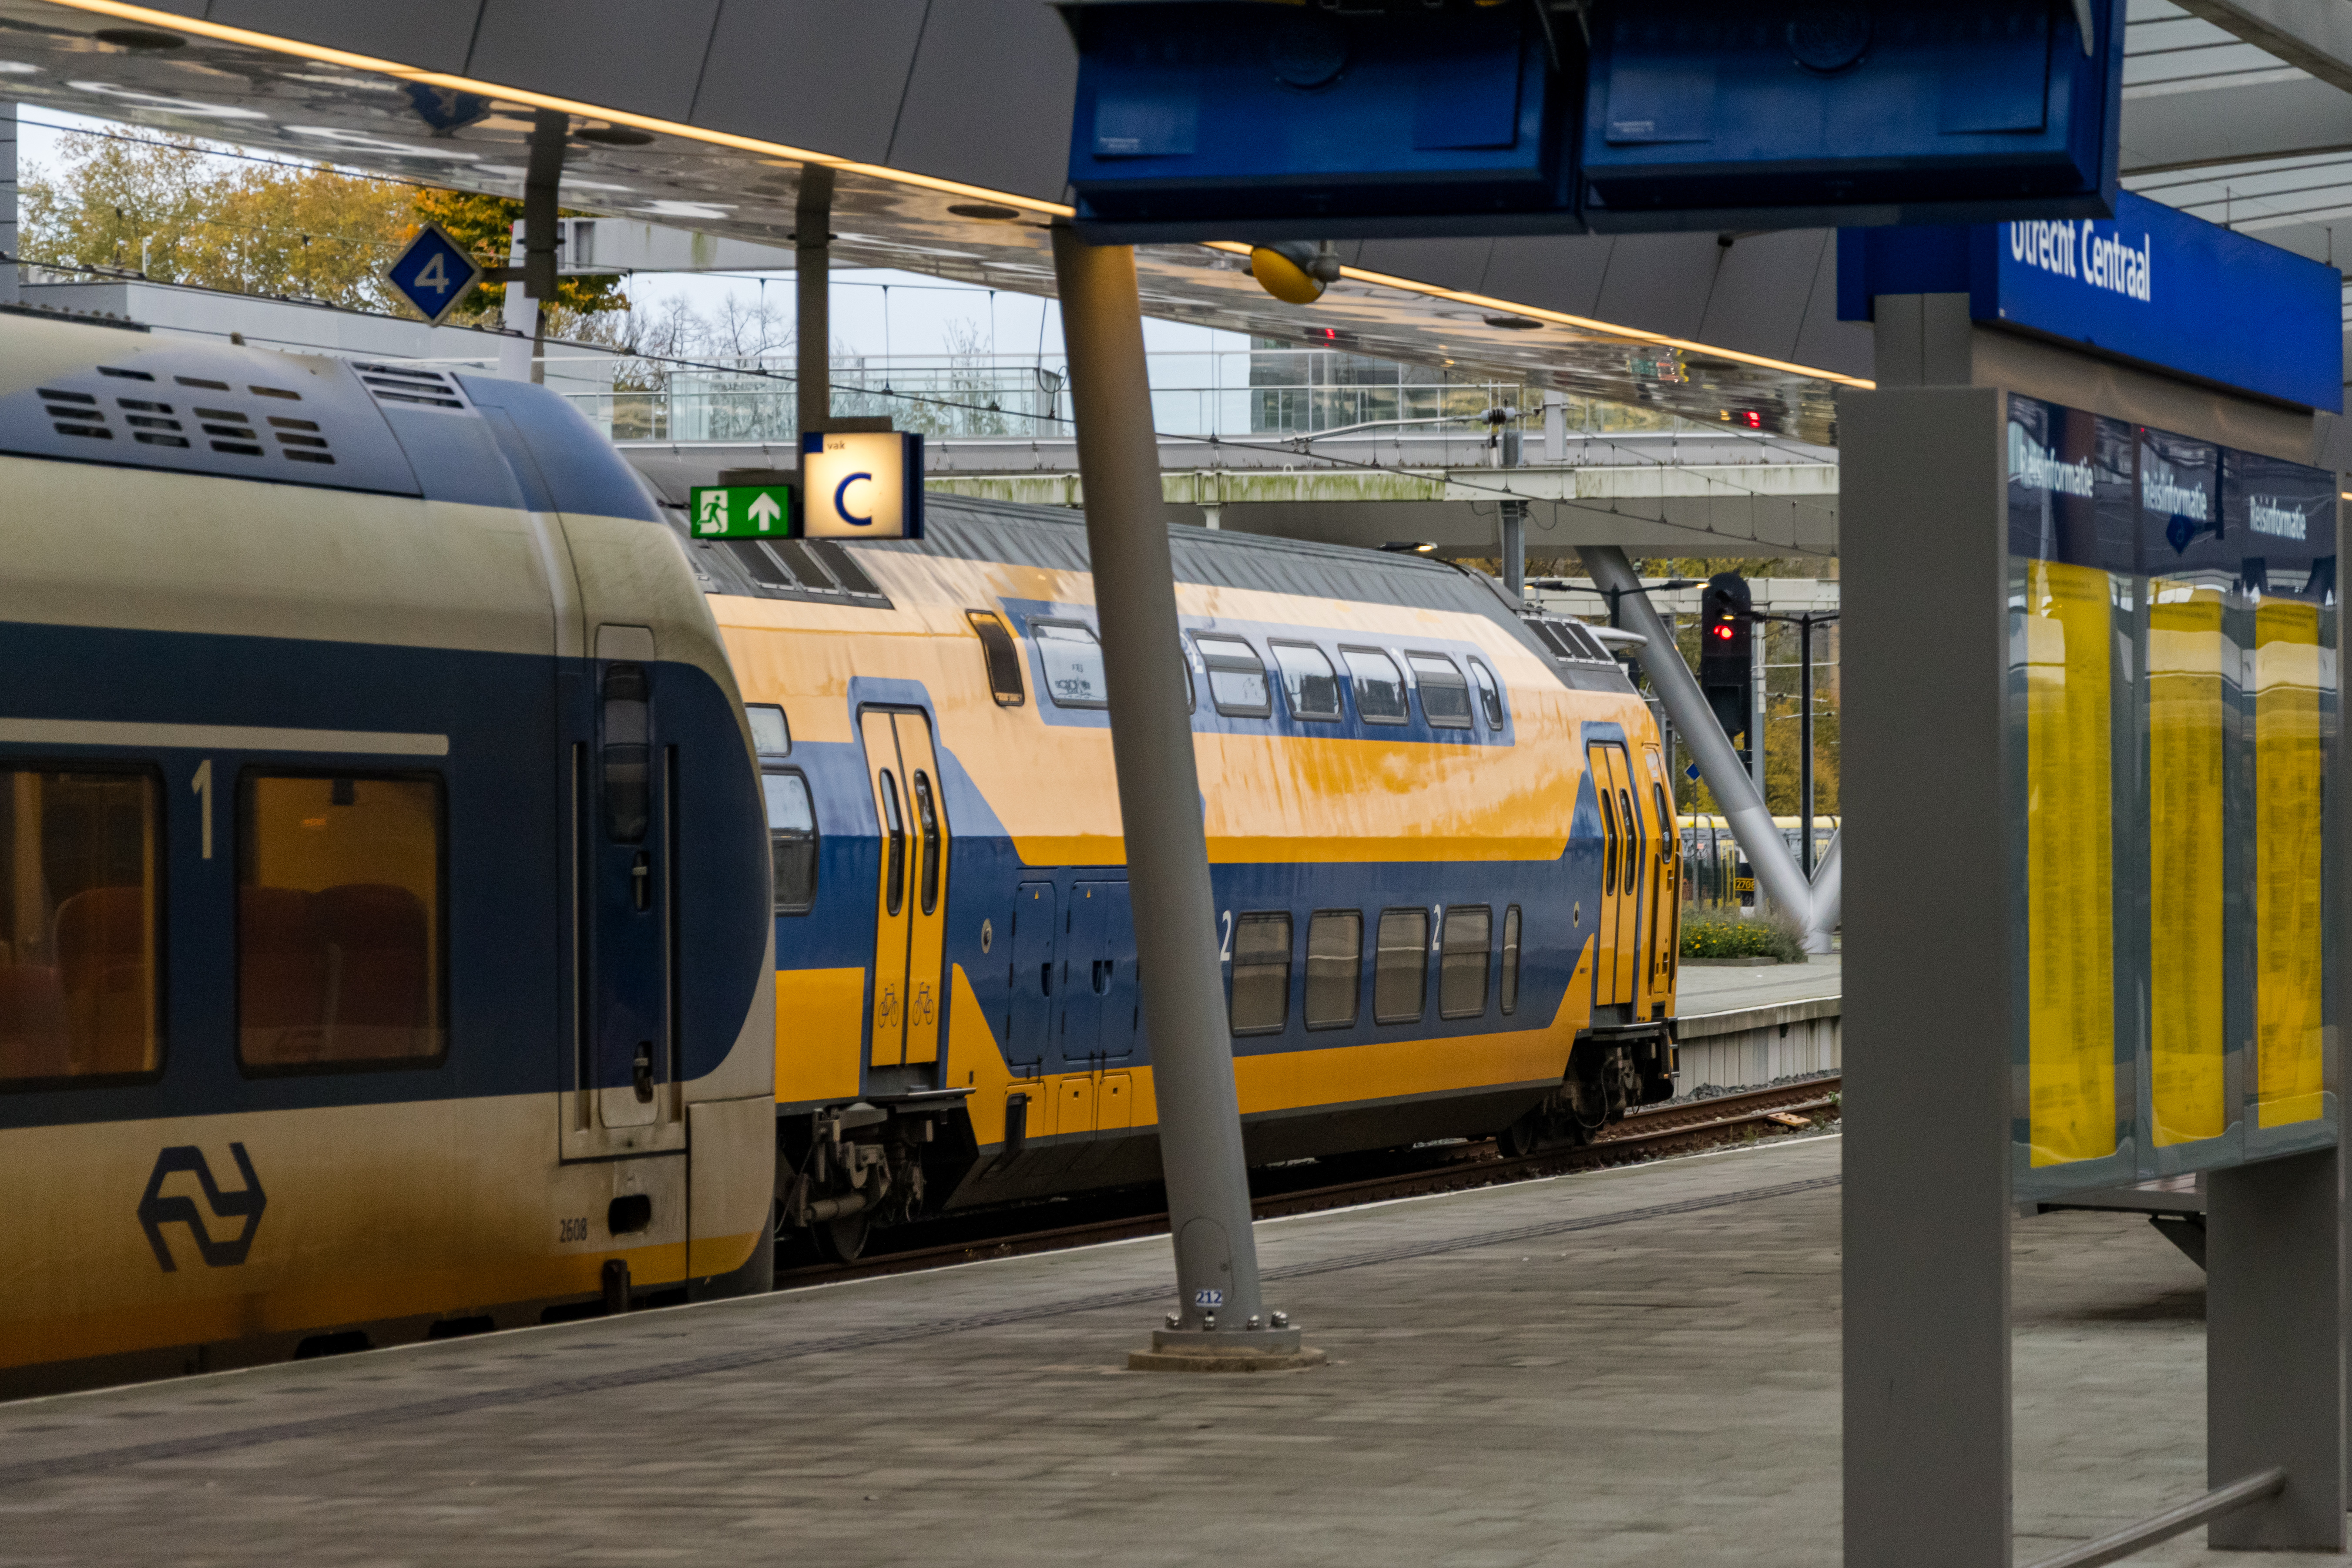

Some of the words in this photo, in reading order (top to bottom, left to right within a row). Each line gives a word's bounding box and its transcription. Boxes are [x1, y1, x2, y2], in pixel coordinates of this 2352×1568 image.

[414, 252, 450, 294] 4
[2011, 218, 2077, 279] Utrecht
[2081, 218, 2151, 302] Centraal
[827, 440, 846, 450] vak
[834, 471, 872, 526] C
[2142, 470, 2207, 521] Reisinformatie
[2250, 494, 2306, 541] Reisinformatie
[191, 759, 212, 859] 1
[1220, 910, 1231, 961] 2
[1432, 904, 1441, 951] 2
[560, 1217, 587, 1243] 2608
[1196, 1291, 1222, 1303] 212
